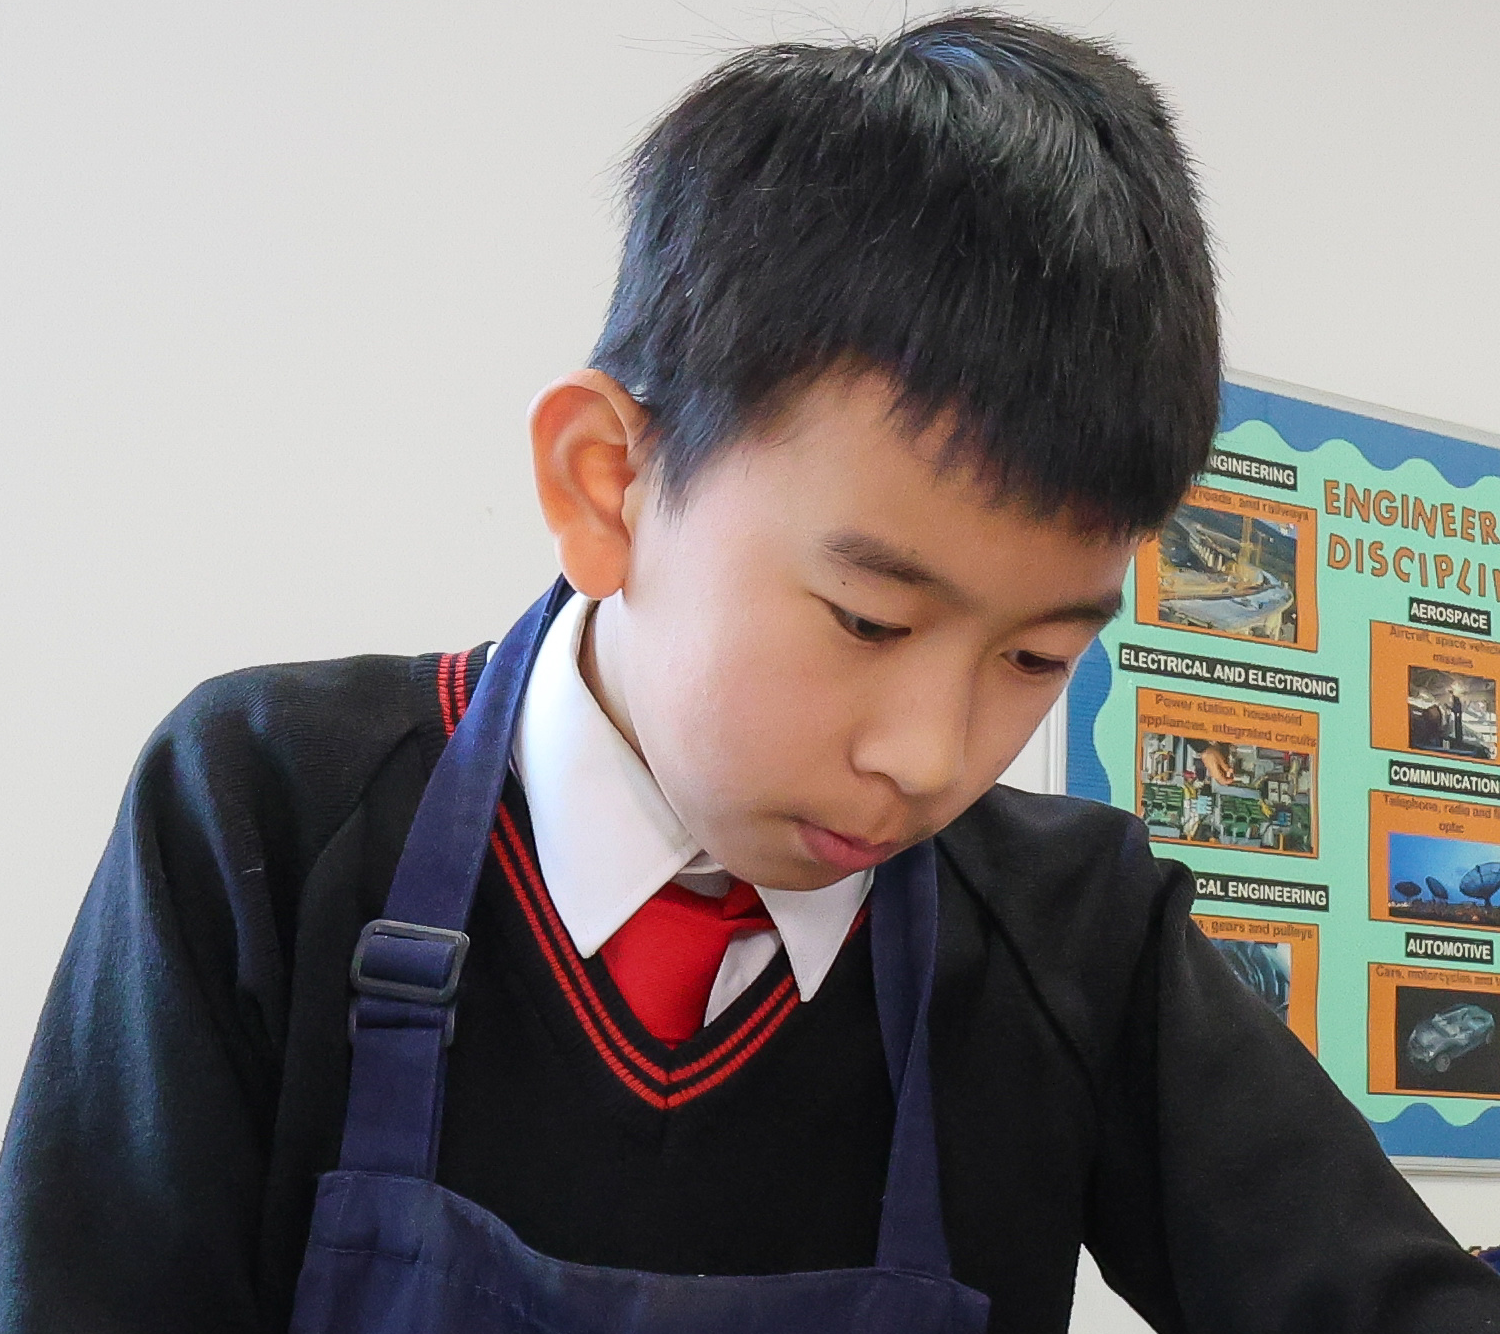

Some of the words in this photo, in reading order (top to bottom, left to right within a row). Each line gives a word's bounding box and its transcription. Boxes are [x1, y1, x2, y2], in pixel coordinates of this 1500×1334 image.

[1210, 455, 1295, 485] NGINEERING
[1411, 602, 1488, 629] AEROSPACE
[1435, 636, 1467, 650] space
[1121, 648, 1210, 677] ELECTRICAL
[1213, 665, 1246, 684] AND
[1249, 668, 1337, 697] ELECTRONIC
[1155, 693, 1192, 710] Power
[1473, 805, 1492, 819] and
[1228, 881, 1327, 906] ENGINEERING
[1248, 923, 1270, 935] and
[1407, 938, 1491, 960] AUTOMOTIVE
